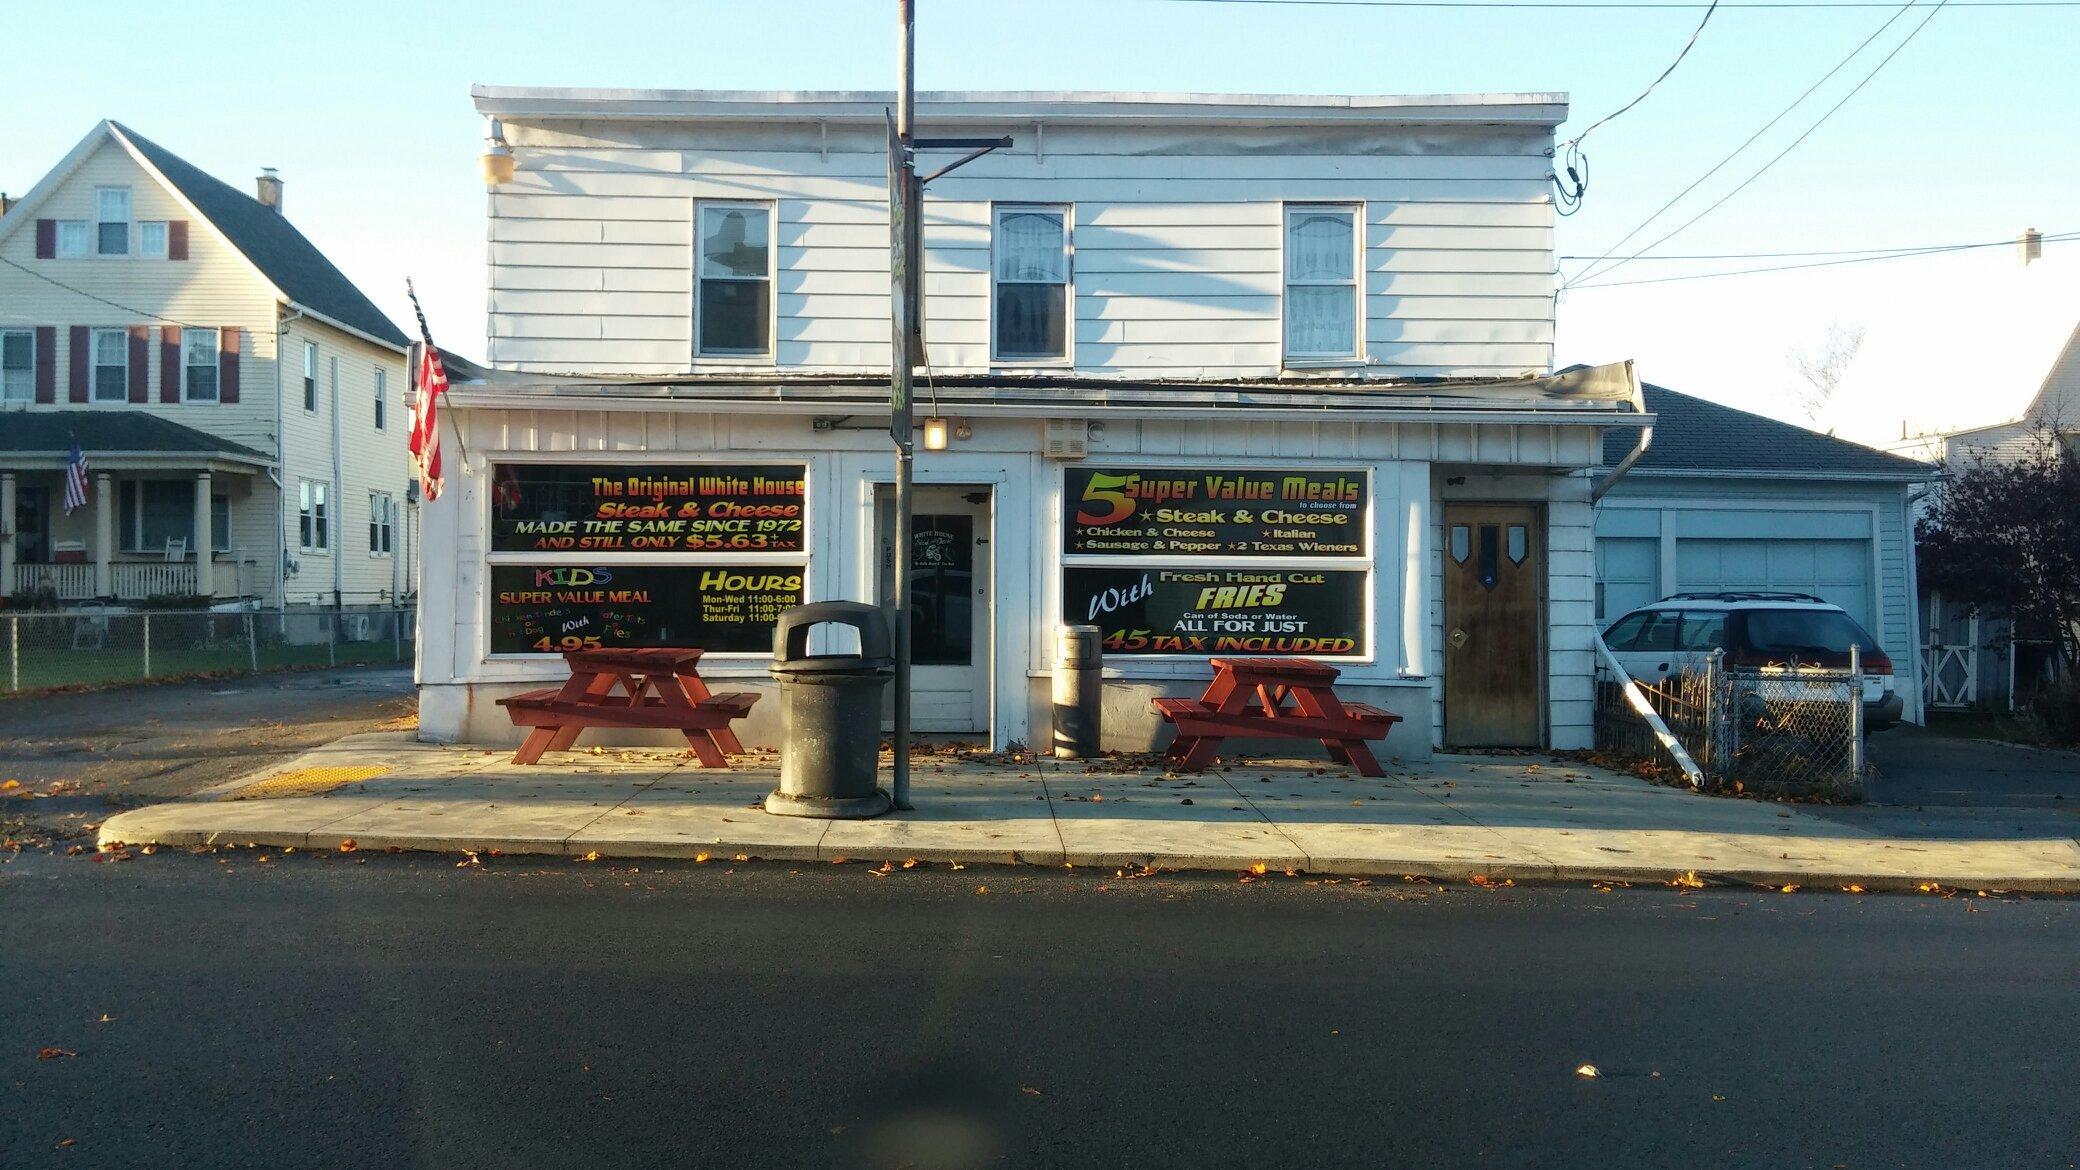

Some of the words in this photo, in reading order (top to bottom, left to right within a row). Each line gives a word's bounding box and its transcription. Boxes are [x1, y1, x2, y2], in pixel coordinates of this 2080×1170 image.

[592, 478, 622, 496] The
[628, 476, 694, 502] Original
[700, 476, 748, 495] White
[754, 477, 805, 495] House
[1076, 471, 1138, 526] 5
[1125, 473, 1198, 504] Super
[1205, 475, 1273, 500] Value
[1282, 477, 1359, 501] Meals
[596, 502, 672, 518] Steak
[677, 502, 700, 517] &
[708, 502, 799, 517] Cheese
[1156, 509, 1226, 524] Steak
[1233, 510, 1254, 523] &
[1261, 510, 1348, 524] Cheese
[515, 521, 577, 534] MADE
[584, 521, 622, 533] THE
[627, 521, 687, 533] SAME
[691, 520, 750, 532] SINCE
[755, 520, 802, 531] 1972
[1086, 527, 1142, 537] Chicken
[1147, 528, 1159, 537] &
[1163, 529, 1215, 538] Cheese
[1273, 529, 1316, 538] Italian
[534, 537, 575, 548] AND
[579, 537, 625, 548] STILL
[631, 536, 681, 548] ONLY
[686, 533, 769, 549] $5.63
[914, 531, 933, 539] WHITE
[934, 531, 955, 540] HOUSE
[1086, 540, 1149, 551] Sausage
[1153, 541, 1165, 549] &
[1170, 541, 1221, 552] Pepper
[1236, 542, 1248, 551] 2
[1252, 542, 1294, 551] Texas
[1298, 542, 1358, 552] Wieners
[534, 567, 613, 587] KIDS
[1159, 572, 1219, 583] Fresh
[1226, 573, 1282, 583] Hand
[1287, 573, 1325, 583] Cut
[500, 592, 552, 604] SUPER
[557, 592, 605, 604] VALUE
[609, 591, 652, 603] MEAL
[702, 595, 745, 603] Mon-Wed
[748, 595, 796, 603] 11:00-6:00
[1088, 574, 1154, 621] With
[1195, 584, 1287, 610] FRIES
[703, 605, 740, 613] Thur-Fri
[561, 617, 590, 633] With
[702, 614, 745, 623] Saturday
[1174, 620, 1208, 632] ALL
[1213, 621, 1254, 632] FOR
[1260, 621, 1308, 633] JUST
[533, 636, 602, 652] 4.95
[1153, 637, 1209, 650] TAX
[1214, 636, 1355, 652] INCLUDED
